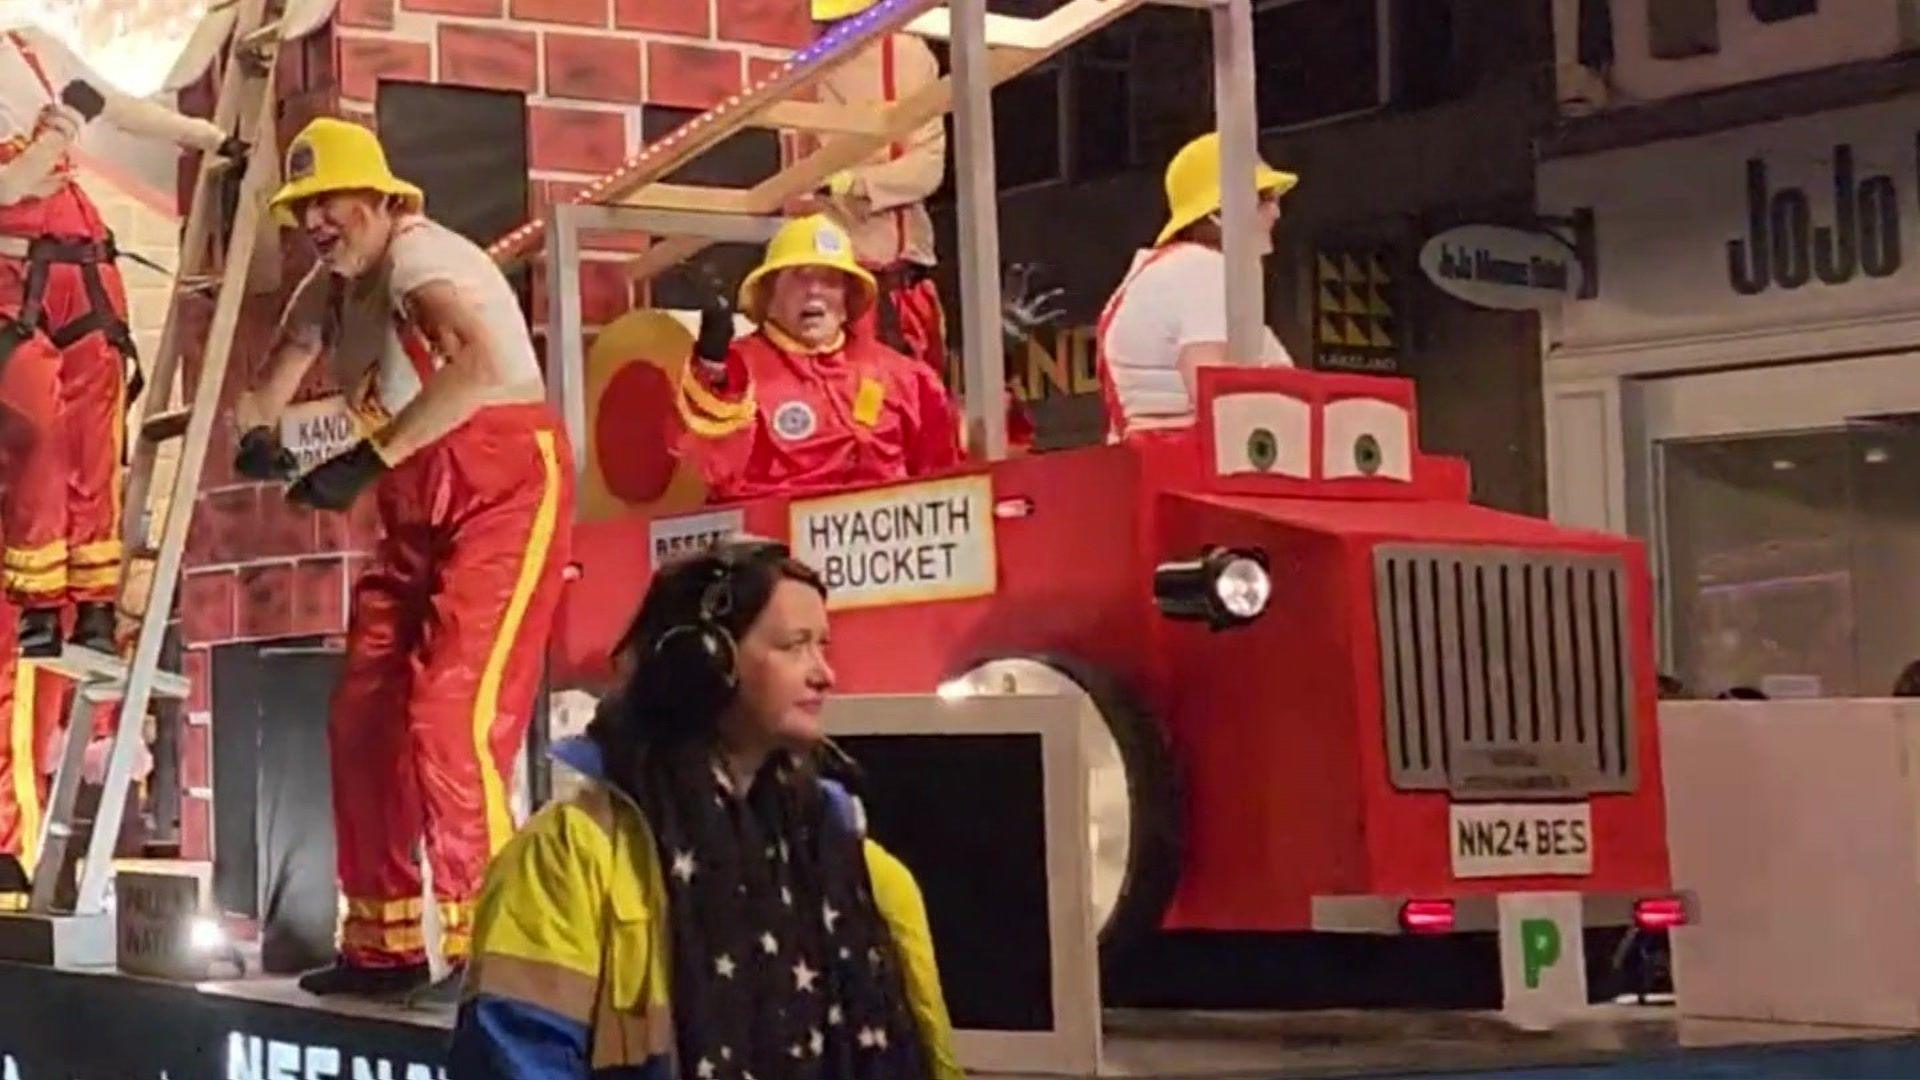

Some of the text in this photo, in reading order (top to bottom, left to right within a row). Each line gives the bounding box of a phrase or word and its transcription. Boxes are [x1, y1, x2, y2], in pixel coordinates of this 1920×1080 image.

[1727, 143, 1902, 296] JoJo
[809, 497, 970, 549] HYACINTH
[825, 542, 958, 589] BUCKET
[1457, 818, 1588, 858] NN24 BES
[1520, 918, 1562, 990] P
